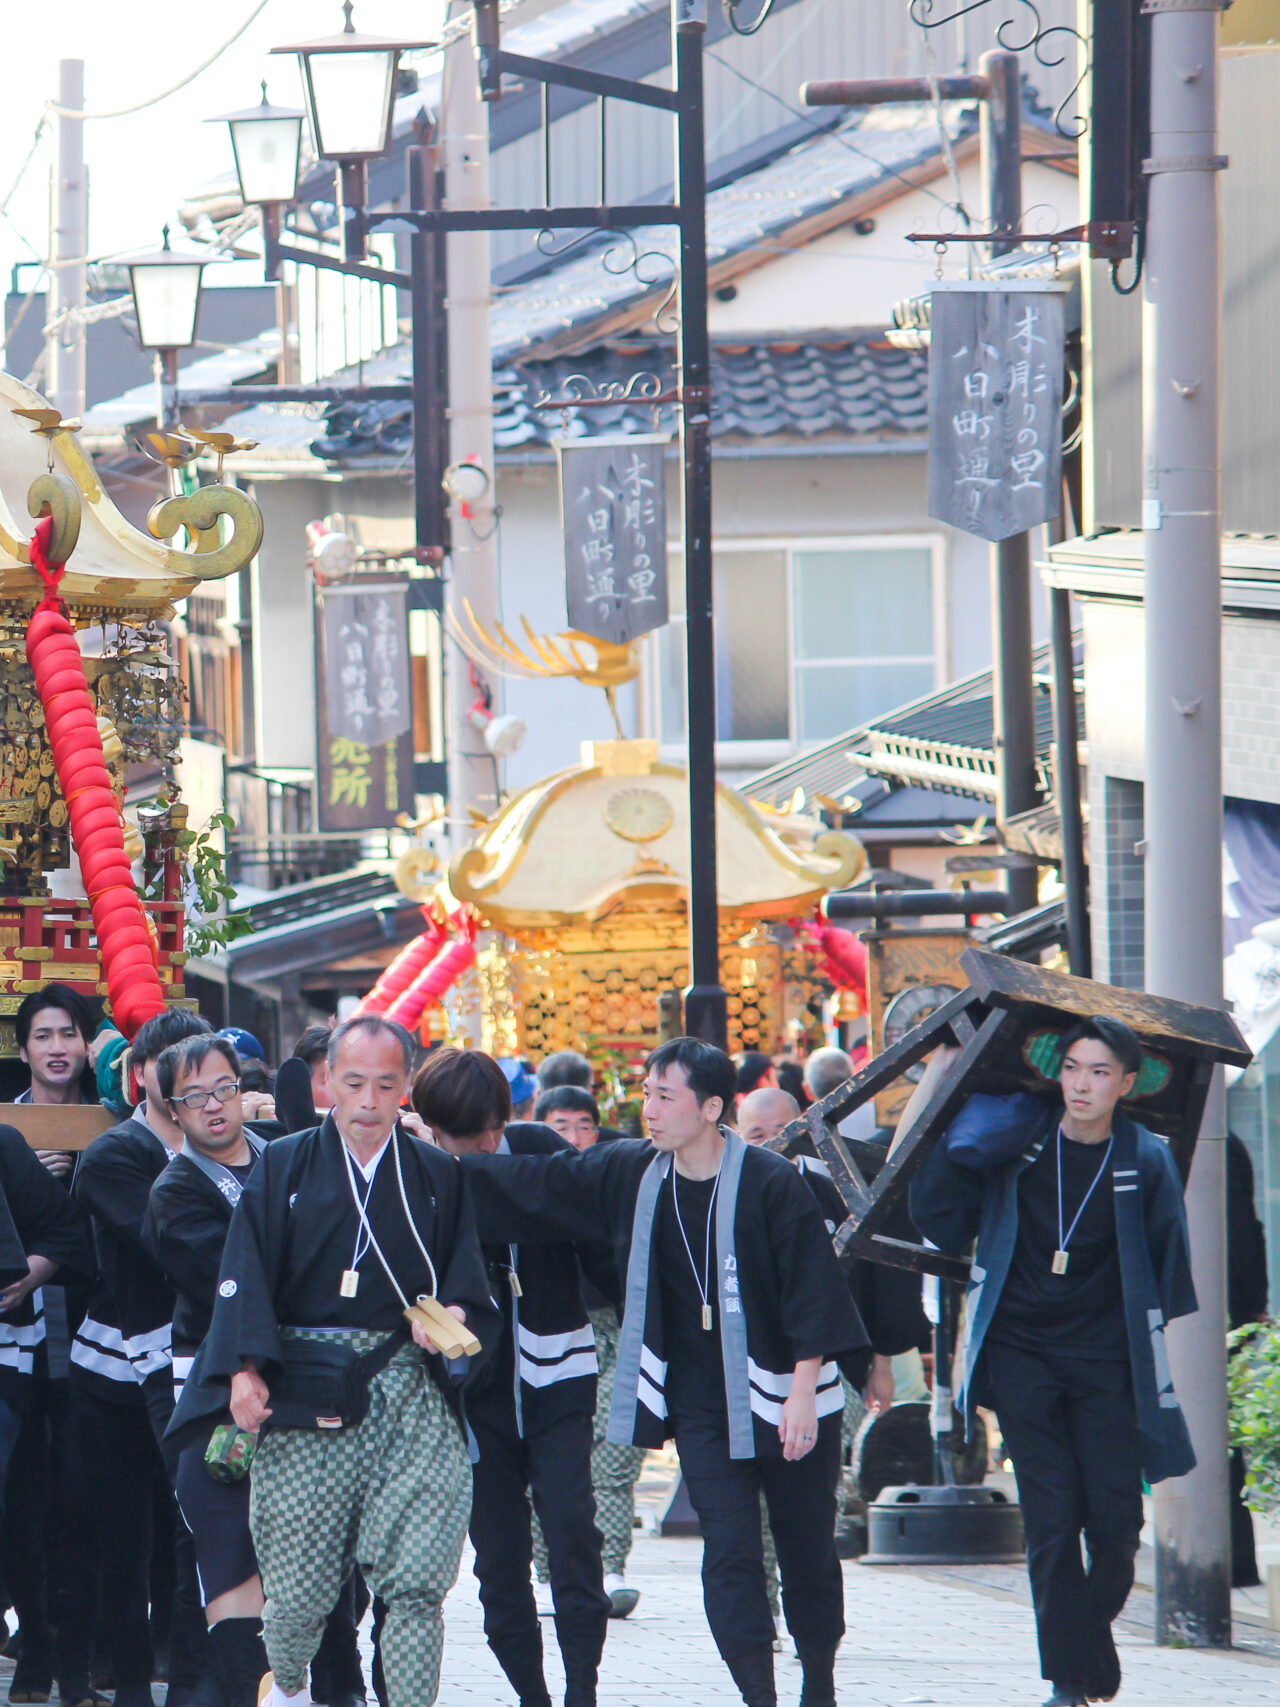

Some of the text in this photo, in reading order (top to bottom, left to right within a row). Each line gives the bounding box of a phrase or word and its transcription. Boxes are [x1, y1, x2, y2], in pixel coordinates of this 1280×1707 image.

[952, 342, 1002, 514] 八日町通り
[1009, 305, 1048, 491] 木彫りの里
[576, 485, 626, 621] 八日町通り
[624, 453, 656, 603] 木彫りの里
